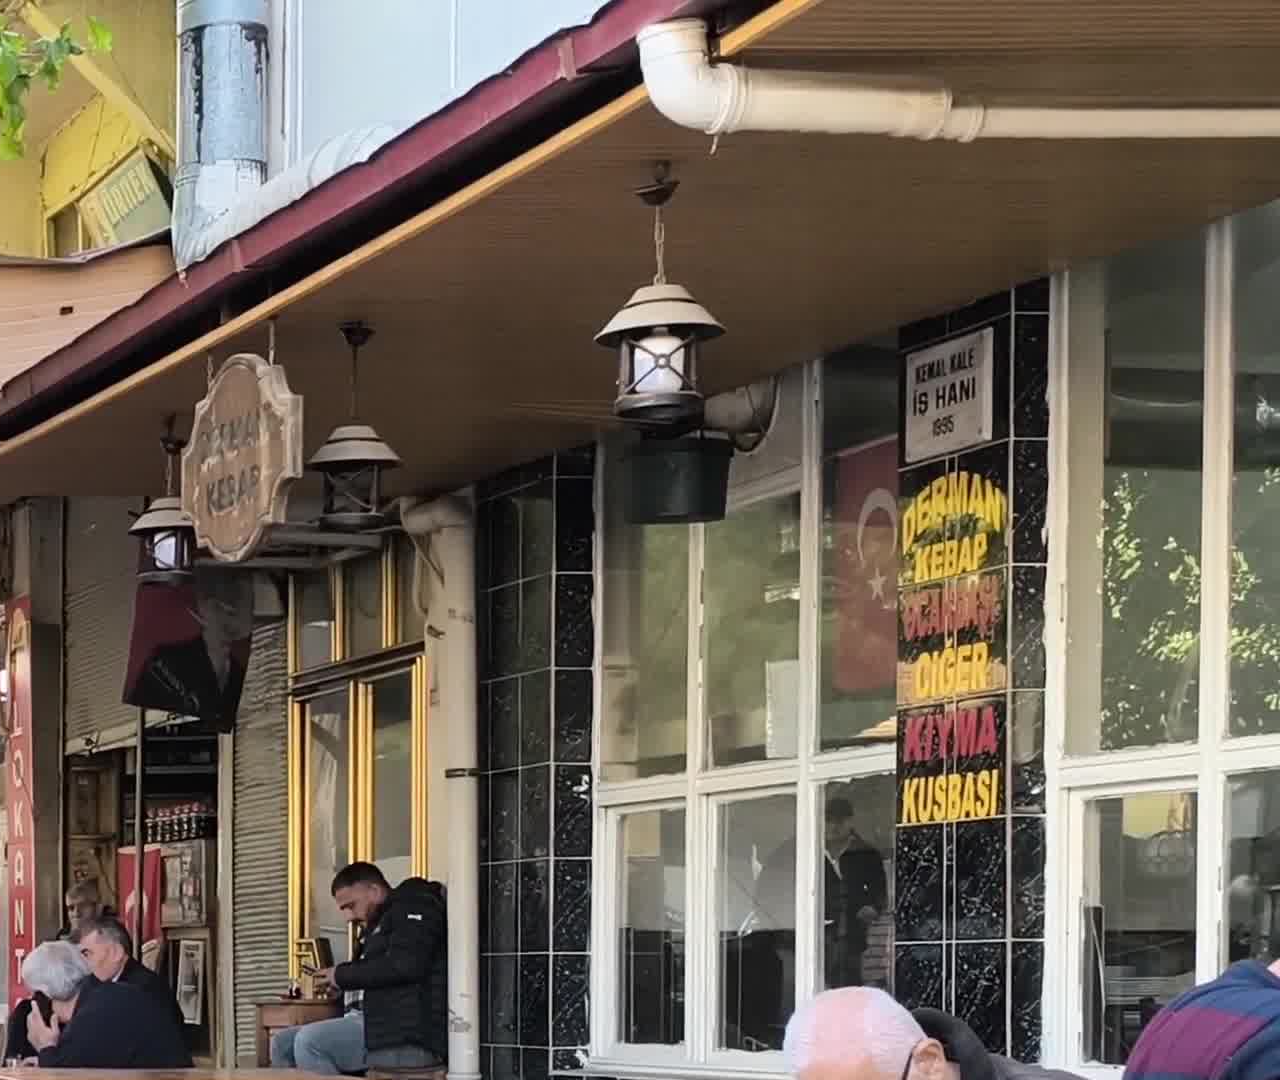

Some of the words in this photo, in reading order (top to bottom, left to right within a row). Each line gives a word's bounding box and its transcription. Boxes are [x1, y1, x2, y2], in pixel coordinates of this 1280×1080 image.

[915, 358, 947, 384] KEMAL
[950, 346, 976, 374] KALE
[935, 376, 977, 410] HANI
[902, 471, 1005, 556] DERMAN
[913, 532, 989, 584] KEBAP
[903, 705, 999, 763] KIYMA
[7, 703, 26, 1008] LOKANT
